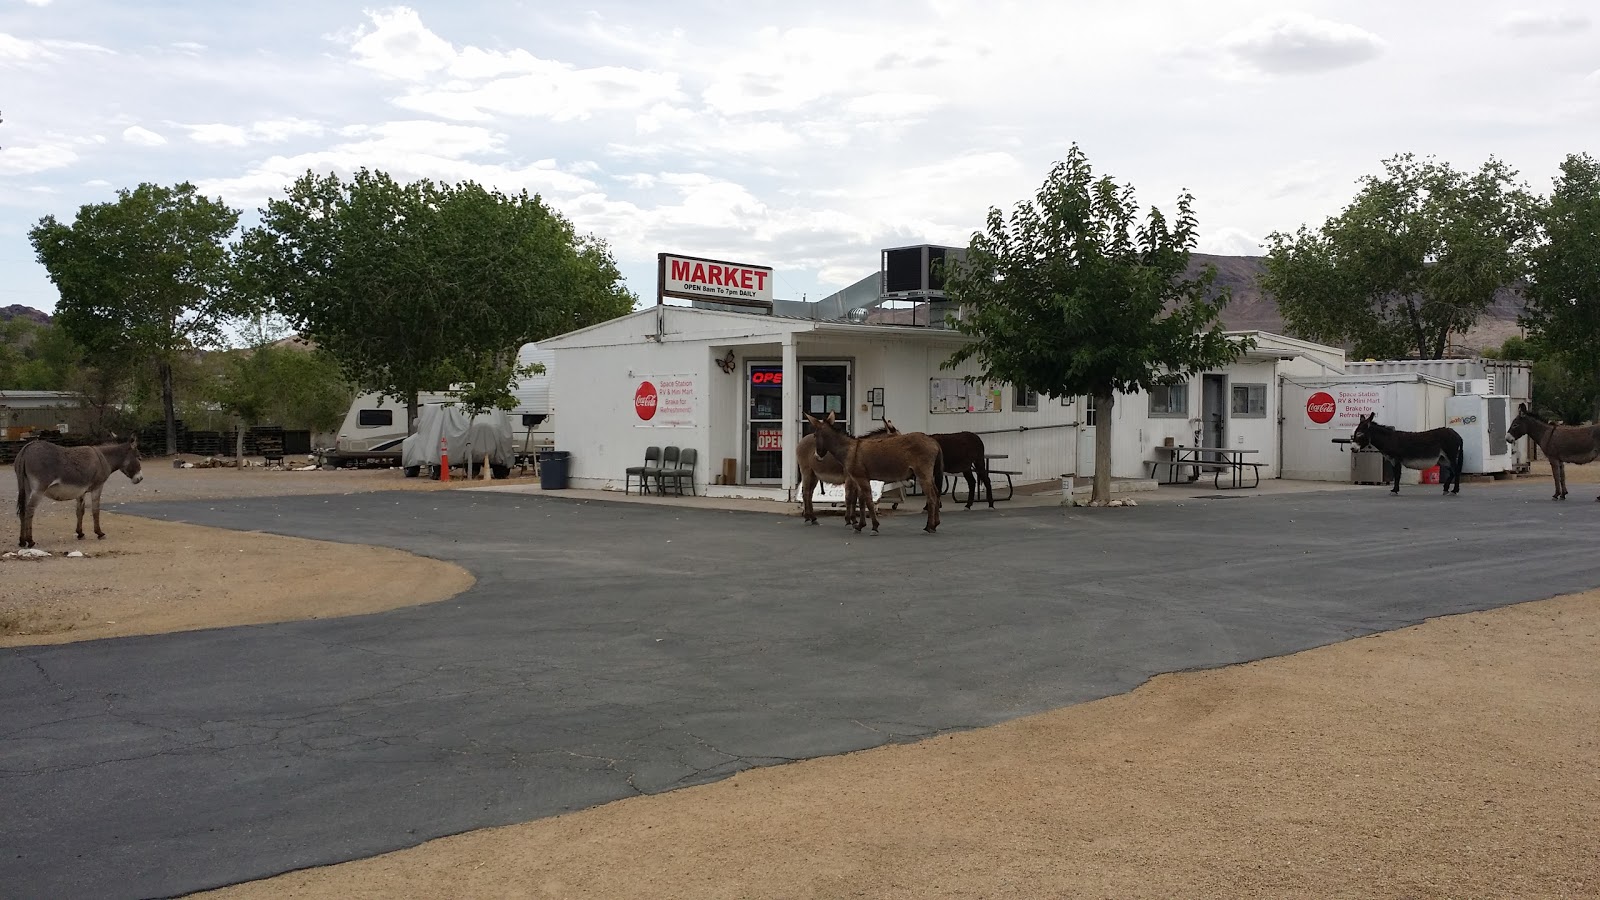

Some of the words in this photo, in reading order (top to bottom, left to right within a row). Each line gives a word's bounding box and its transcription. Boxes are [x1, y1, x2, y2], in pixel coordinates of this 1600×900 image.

[671, 259, 768, 291] MARKET
[684, 283, 701, 291] OPEN
[702, 285, 715, 293] 8am
[726, 288, 738, 296] 7pm
[752, 372, 783, 383] OPE
[660, 380, 674, 388] Space
